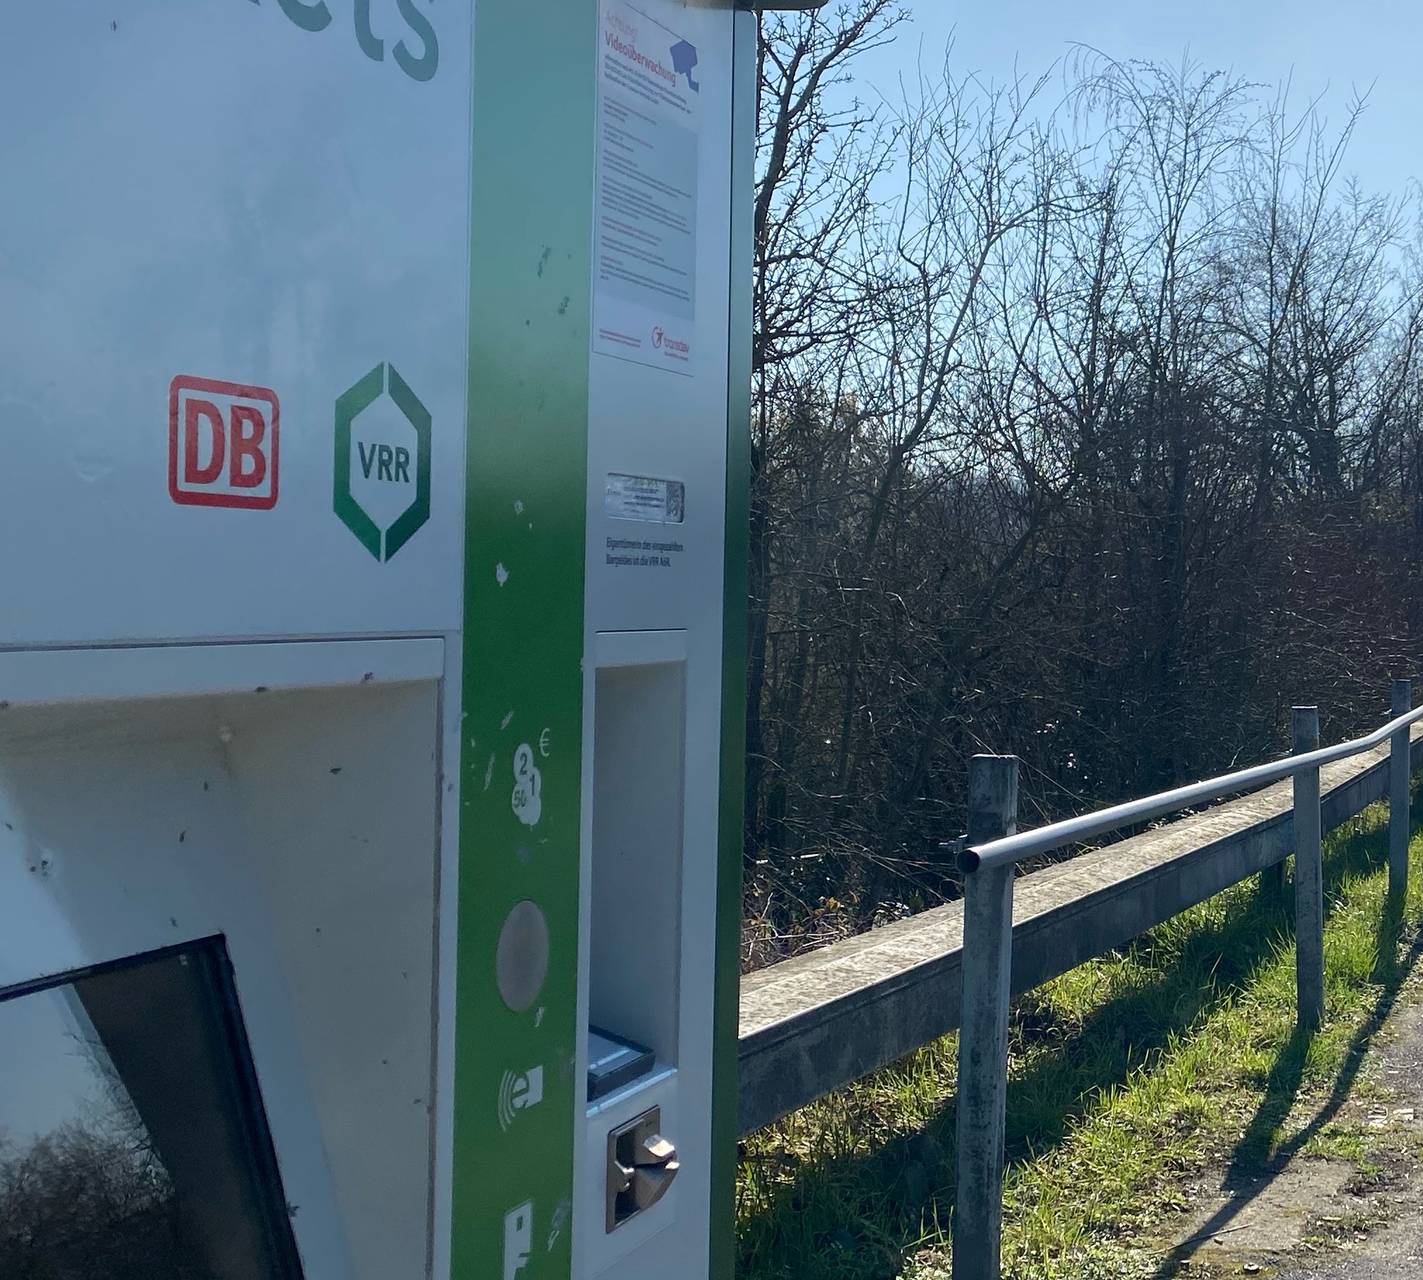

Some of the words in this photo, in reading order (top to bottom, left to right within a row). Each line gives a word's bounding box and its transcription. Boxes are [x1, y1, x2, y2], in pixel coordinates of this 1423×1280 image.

[605, 30, 677, 87] Videoüberwachung
[184, 397, 268, 488] DB
[357, 441, 411, 484] VRR
[519, 752, 528, 776] 2
[513, 789, 528, 809] 50
[529, 773, 536, 797] 1
